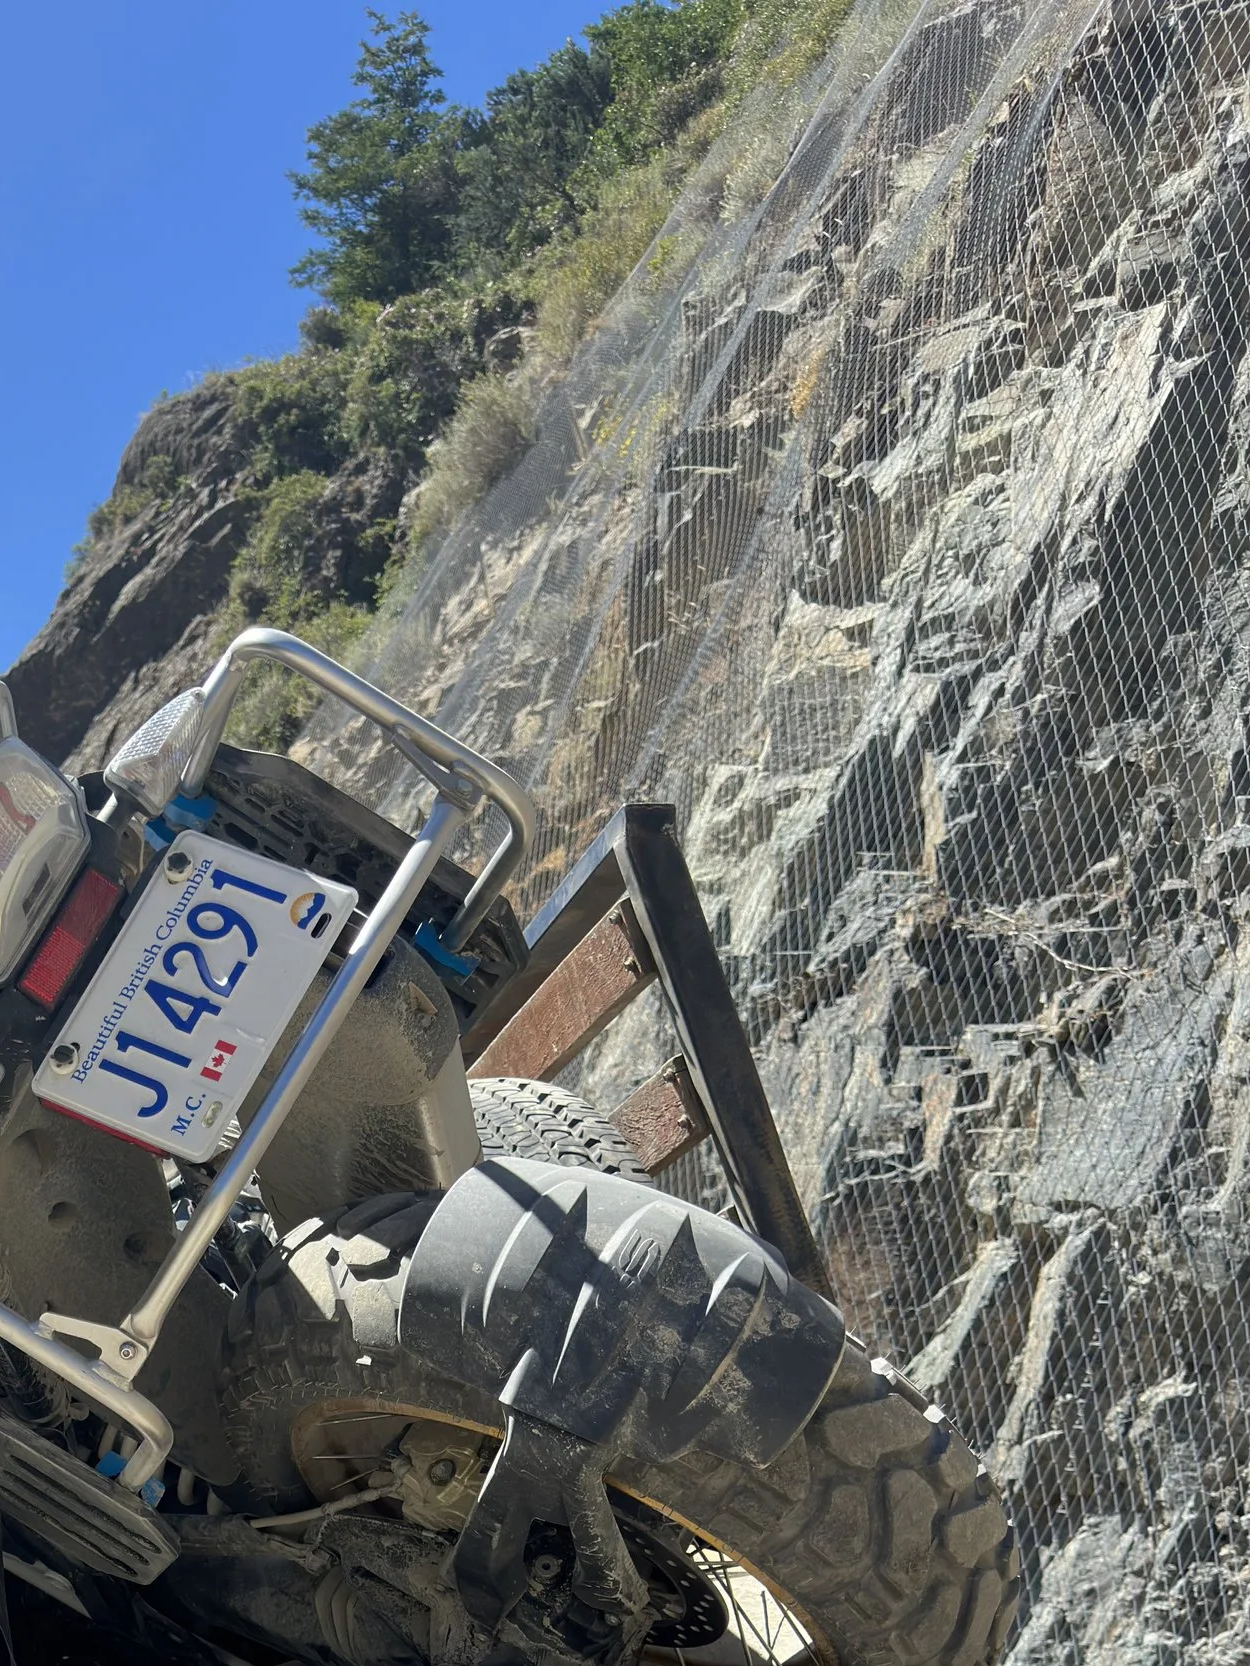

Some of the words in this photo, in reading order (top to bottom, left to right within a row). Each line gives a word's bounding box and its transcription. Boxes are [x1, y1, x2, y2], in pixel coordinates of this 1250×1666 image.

[70, 998, 128, 1085] Beautiful
[119, 947, 162, 1002] British
[156, 858, 214, 942] Columbia
[98, 868, 288, 1118] J14291
[170, 1093, 207, 1137] M.C.
